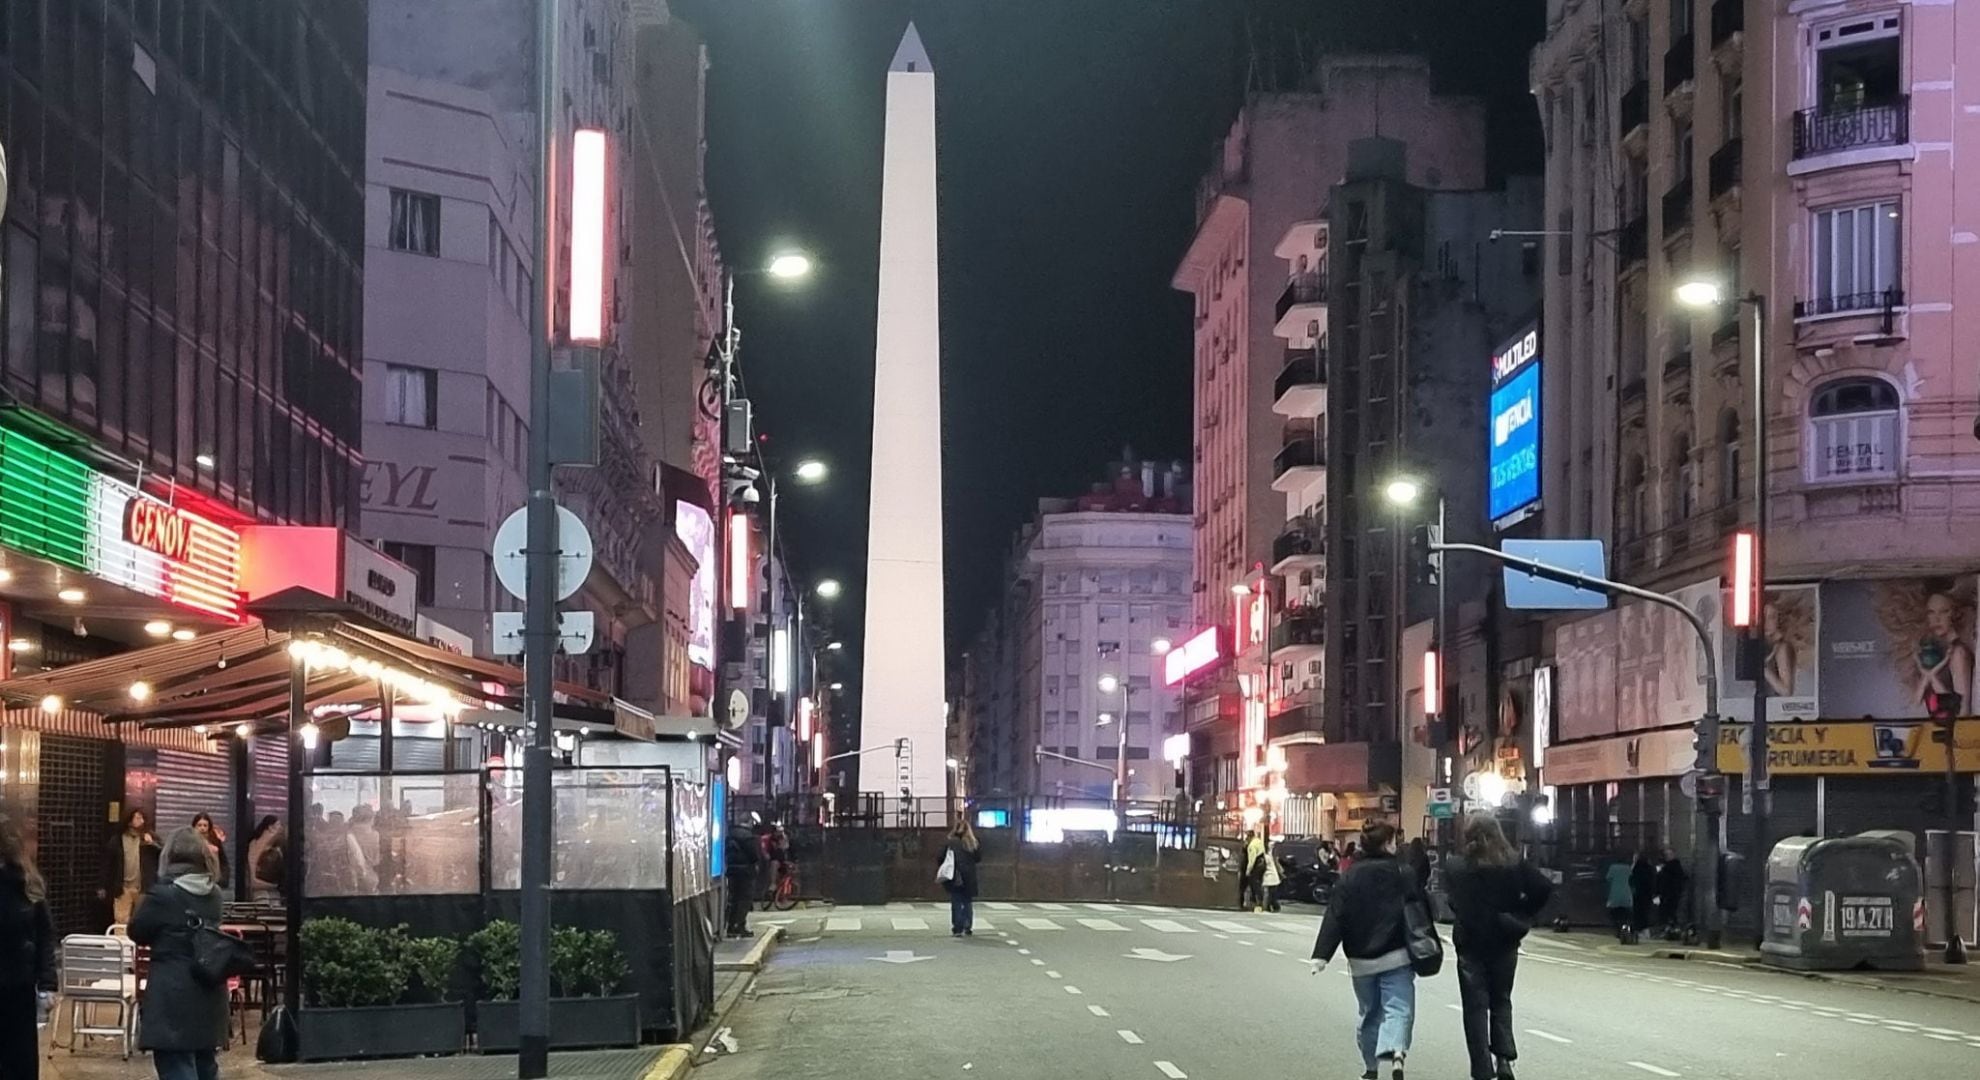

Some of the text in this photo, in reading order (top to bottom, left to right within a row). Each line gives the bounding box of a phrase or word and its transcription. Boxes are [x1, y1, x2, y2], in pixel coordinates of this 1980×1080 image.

[1498, 331, 1536, 379] MULTILED
[1816, 726, 1829, 744] Y
[1840, 907, 1856, 929] 19
